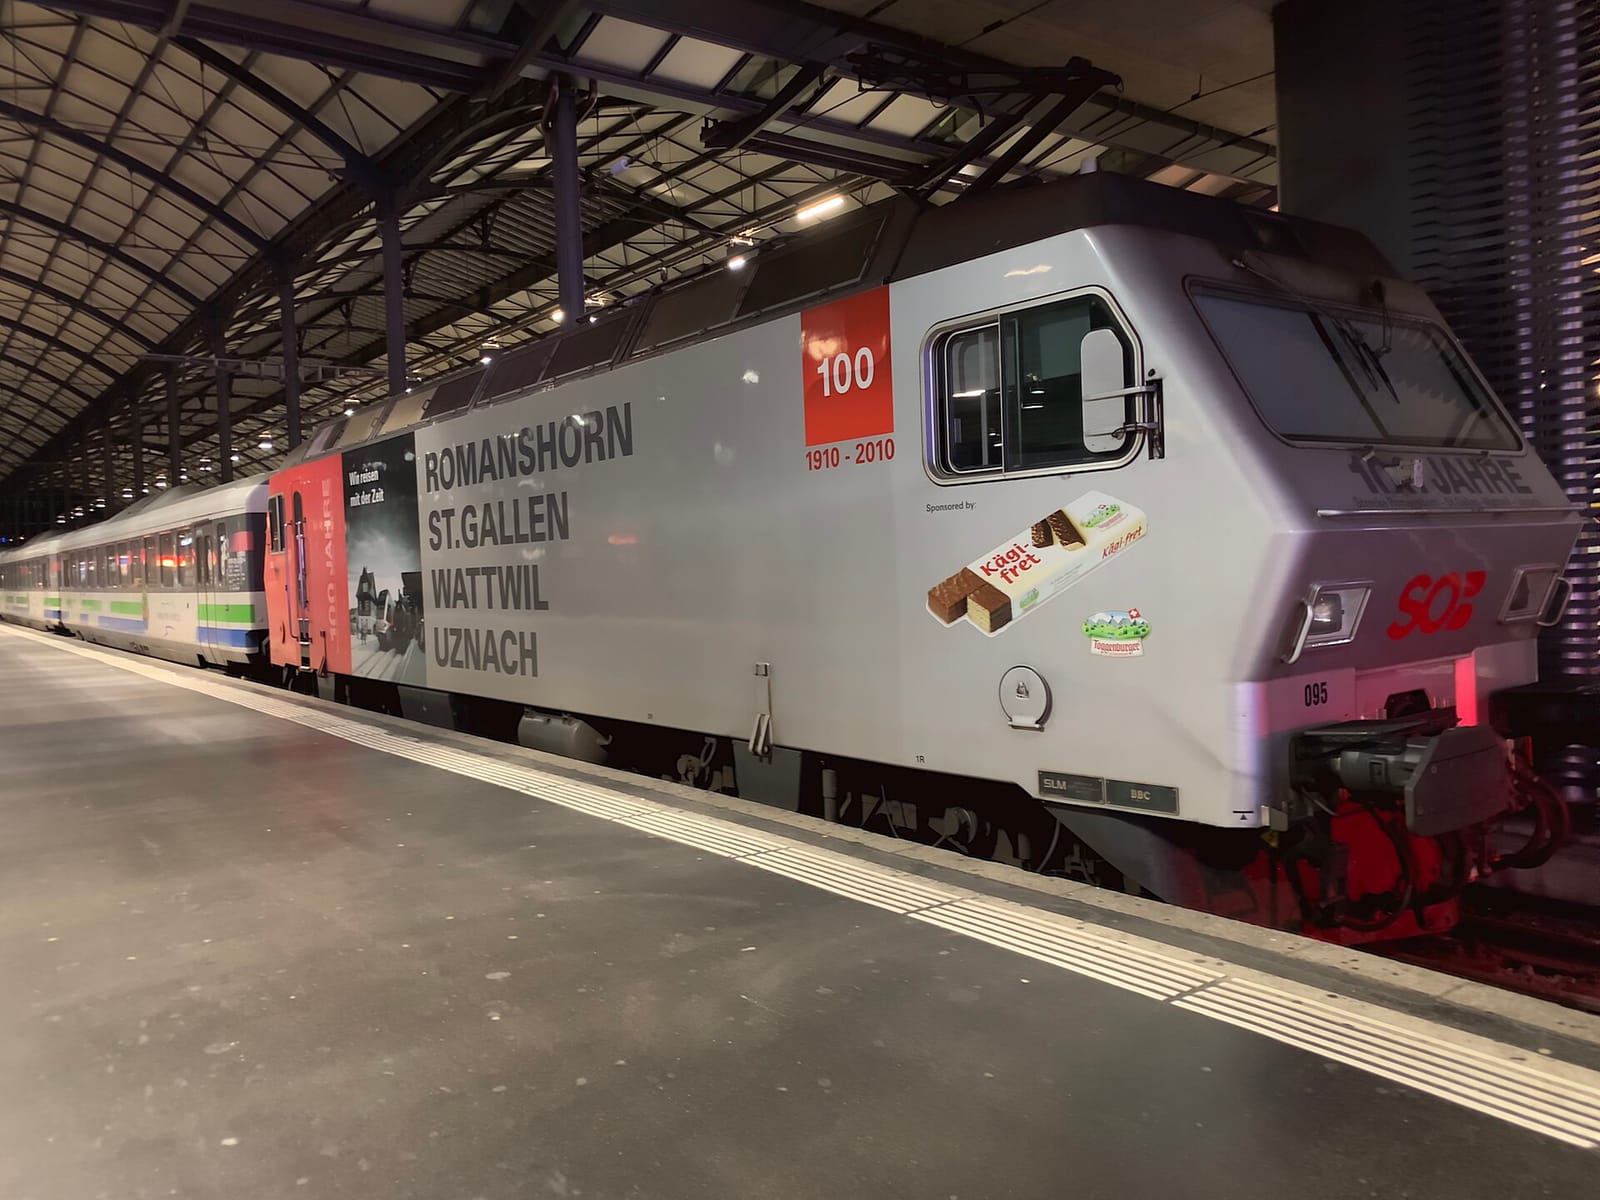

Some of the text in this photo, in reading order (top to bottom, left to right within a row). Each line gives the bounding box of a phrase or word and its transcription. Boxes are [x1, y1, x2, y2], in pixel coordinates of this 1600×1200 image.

[817, 346, 874, 397] 100
[425, 402, 633, 493] ROMANSHORN
[805, 446, 840, 471] 1910
[855, 438, 895, 464] 2010
[360, 468, 379, 484] reisen
[1426, 456, 1533, 494] JAHRE
[361, 490, 371, 504] der
[371, 488, 384, 503] Zeit
[926, 500, 976, 513] Sponsored by:
[428, 491, 570, 551] ST.GALLEN
[1102, 526, 1143, 560] Kägi-fret
[979, 543, 1029, 577] Kägi-
[1000, 553, 1041, 584] fret
[431, 564, 549, 610] WATTWIL
[434, 627, 538, 677] UZNACH
[1094, 639, 1140, 652] Toggenburger
[1304, 682, 1327, 707] 095
[1043, 778, 1067, 791] SLM
[1130, 788, 1152, 801] BBC
